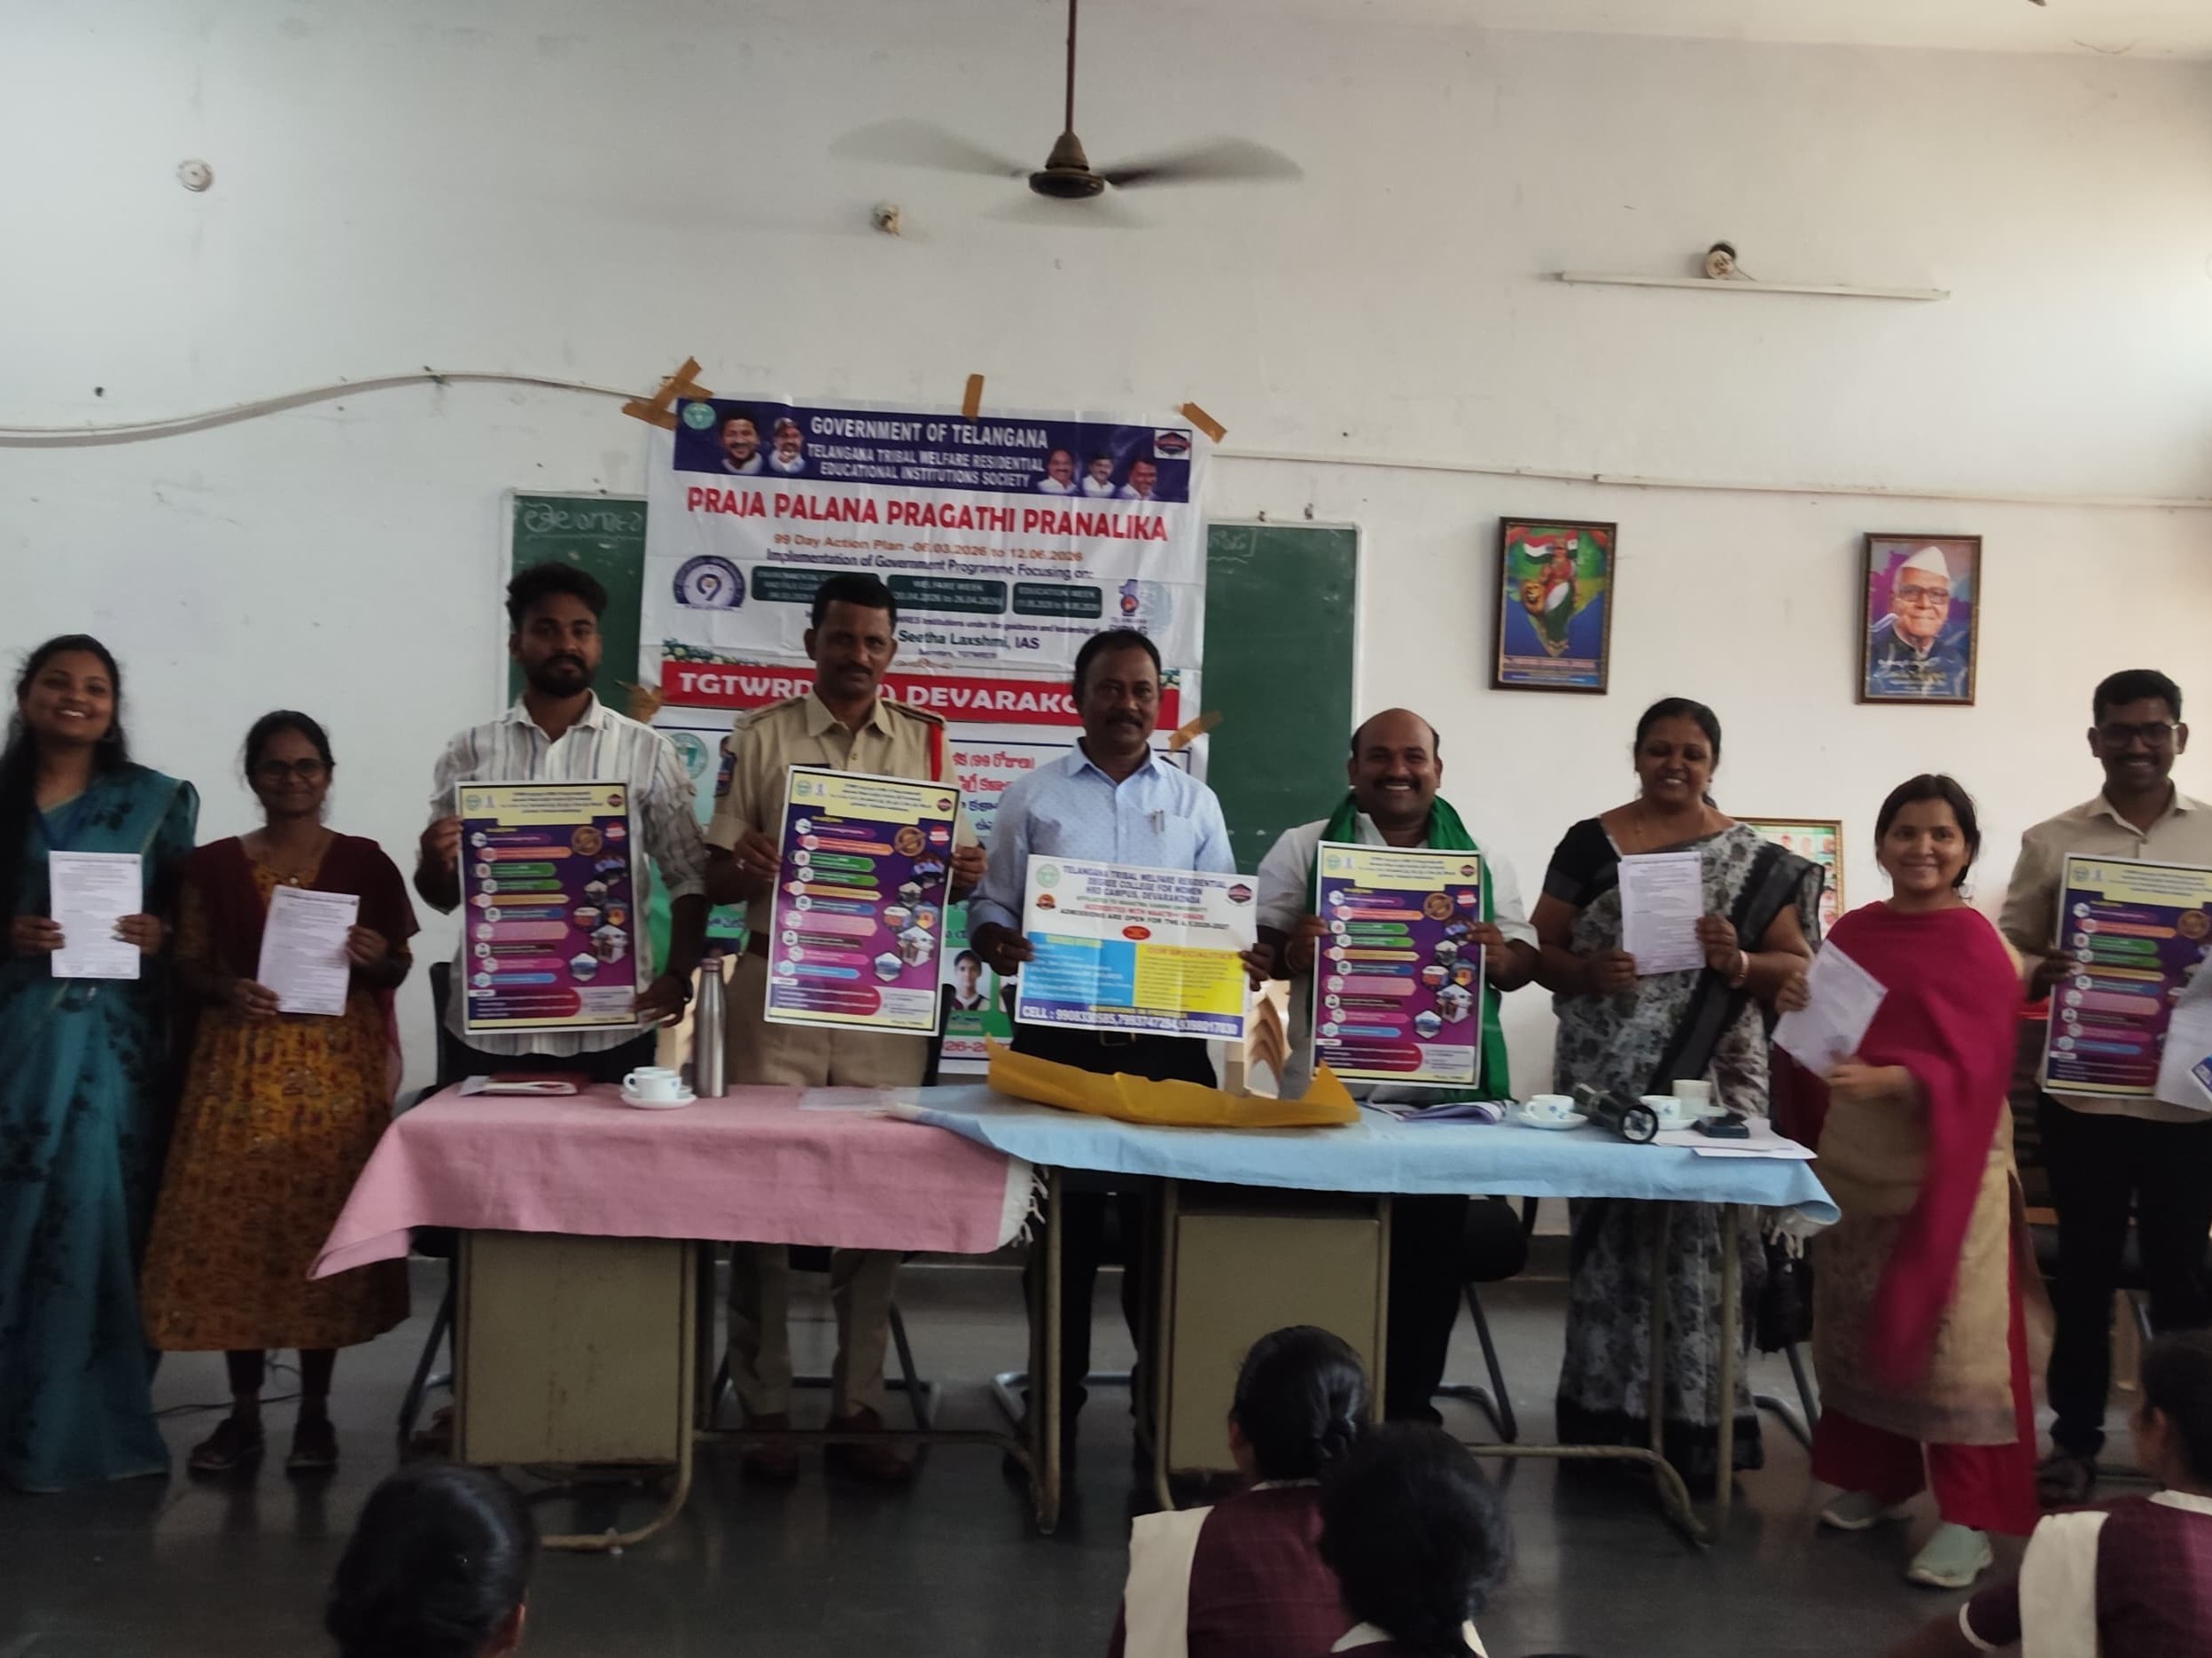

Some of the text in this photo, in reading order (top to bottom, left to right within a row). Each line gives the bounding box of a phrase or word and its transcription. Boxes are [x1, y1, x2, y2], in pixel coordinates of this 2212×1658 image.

[811, 416, 1048, 448] GOVERNMENT OF TELANGANA
[807, 443, 1046, 471] TELANGANA TRIBAL WELFARE RESIDENTIAL
[820, 461, 1031, 487] EDUCATIONAL INSTITUTIONS SOCIETY
[687, 487, 767, 518] PRAJA
[774, 493, 878, 525] PALANA
[887, 499, 1015, 533] PRAGATHI
[1024, 509, 1168, 542] PRANALIKA
[794, 534, 821, 549] Day
[824, 537, 869, 549] Action
[873, 539, 904, 551] Plan
[992, 549, 1005, 557] to
[767, 548, 858, 564] Implementation
[860, 554, 873, 566] of
[948, 559, 1014, 576] Programme
[1017, 564, 1071, 581] Focusing
[899, 629, 946, 644] Seetha
[1015, 636, 1040, 650] IAS
[1022, 1006, 1048, 1018] CELL
